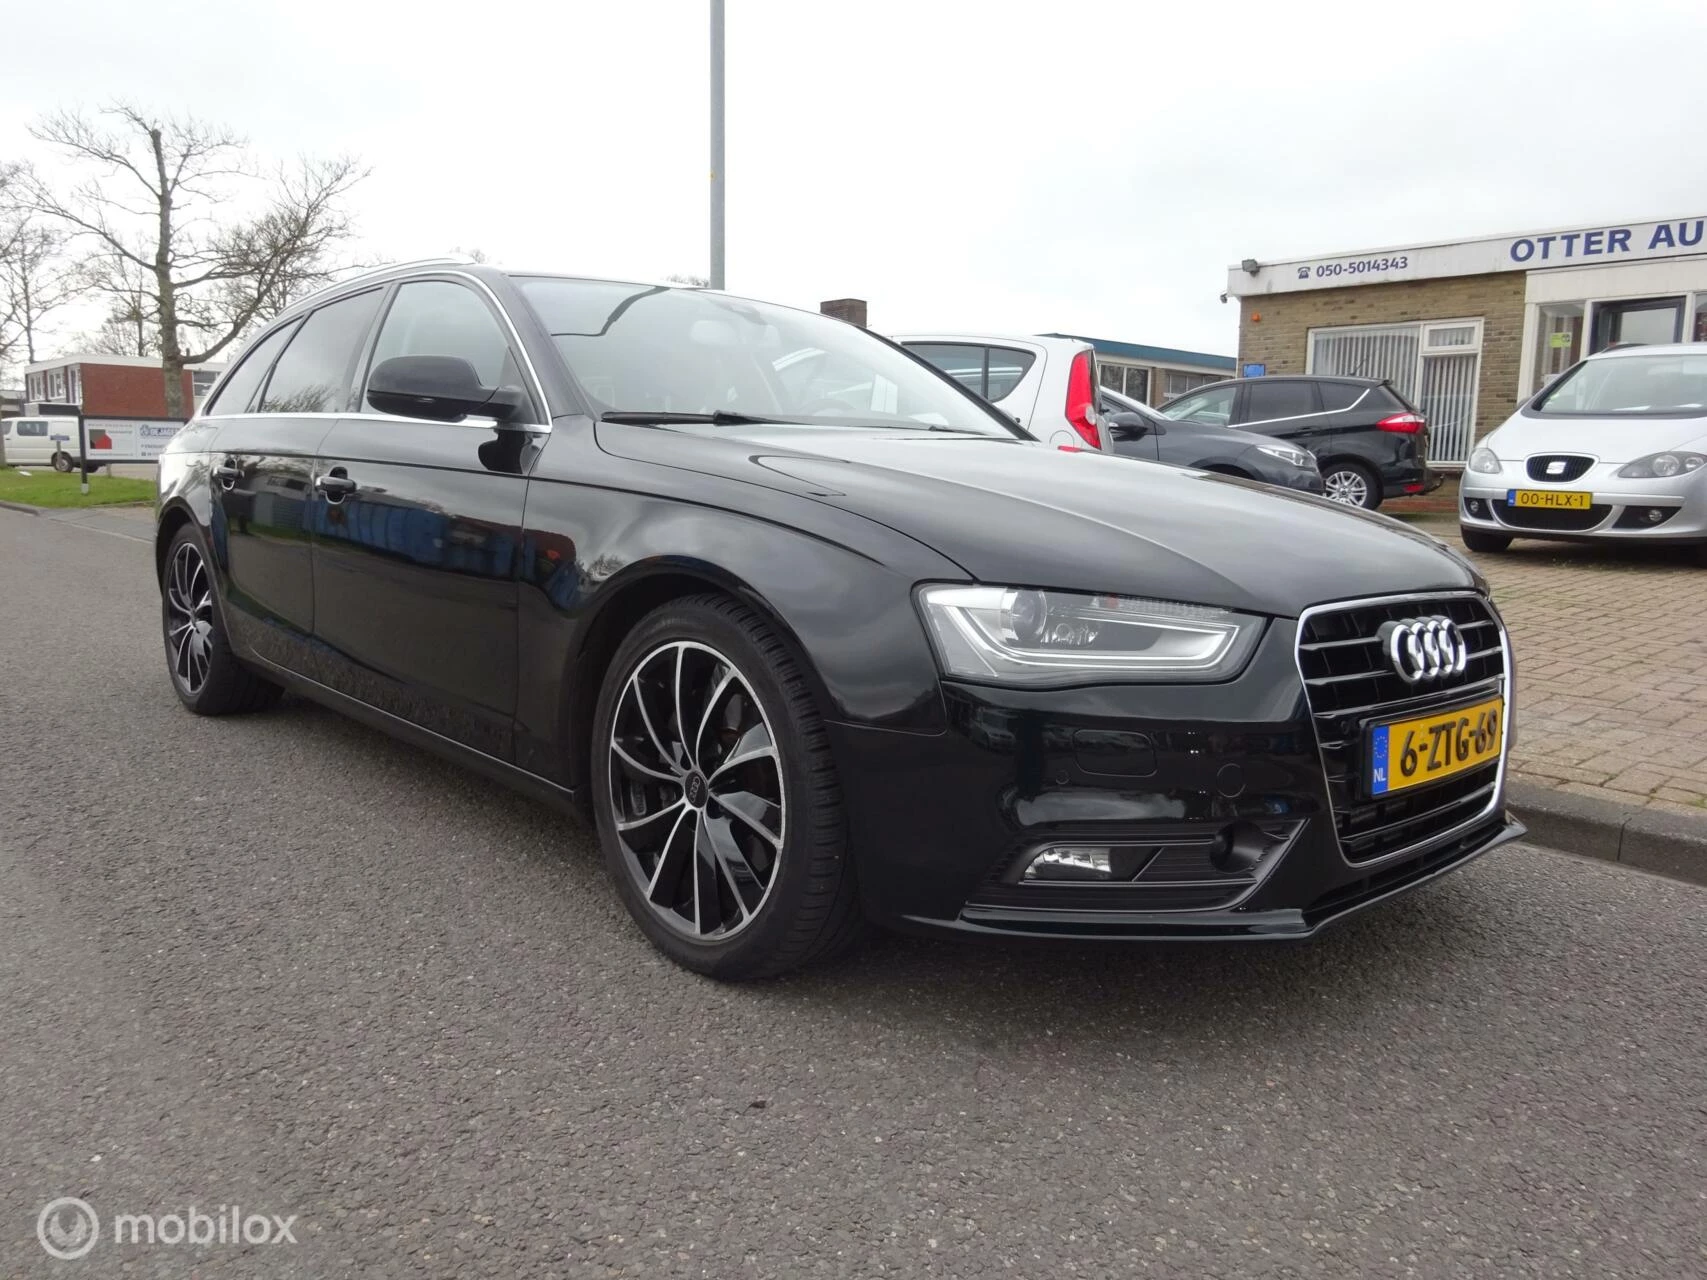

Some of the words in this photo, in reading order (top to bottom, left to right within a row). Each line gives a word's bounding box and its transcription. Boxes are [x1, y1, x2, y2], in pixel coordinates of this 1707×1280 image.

[1510, 229, 1632, 263] OTTER
[1316, 256, 1408, 277] 050-5014343
[1520, 492, 1584, 507] 00-HLX-1
[1400, 708, 1498, 777] 6-ZTG-69
[1373, 768, 1387, 783] NL
